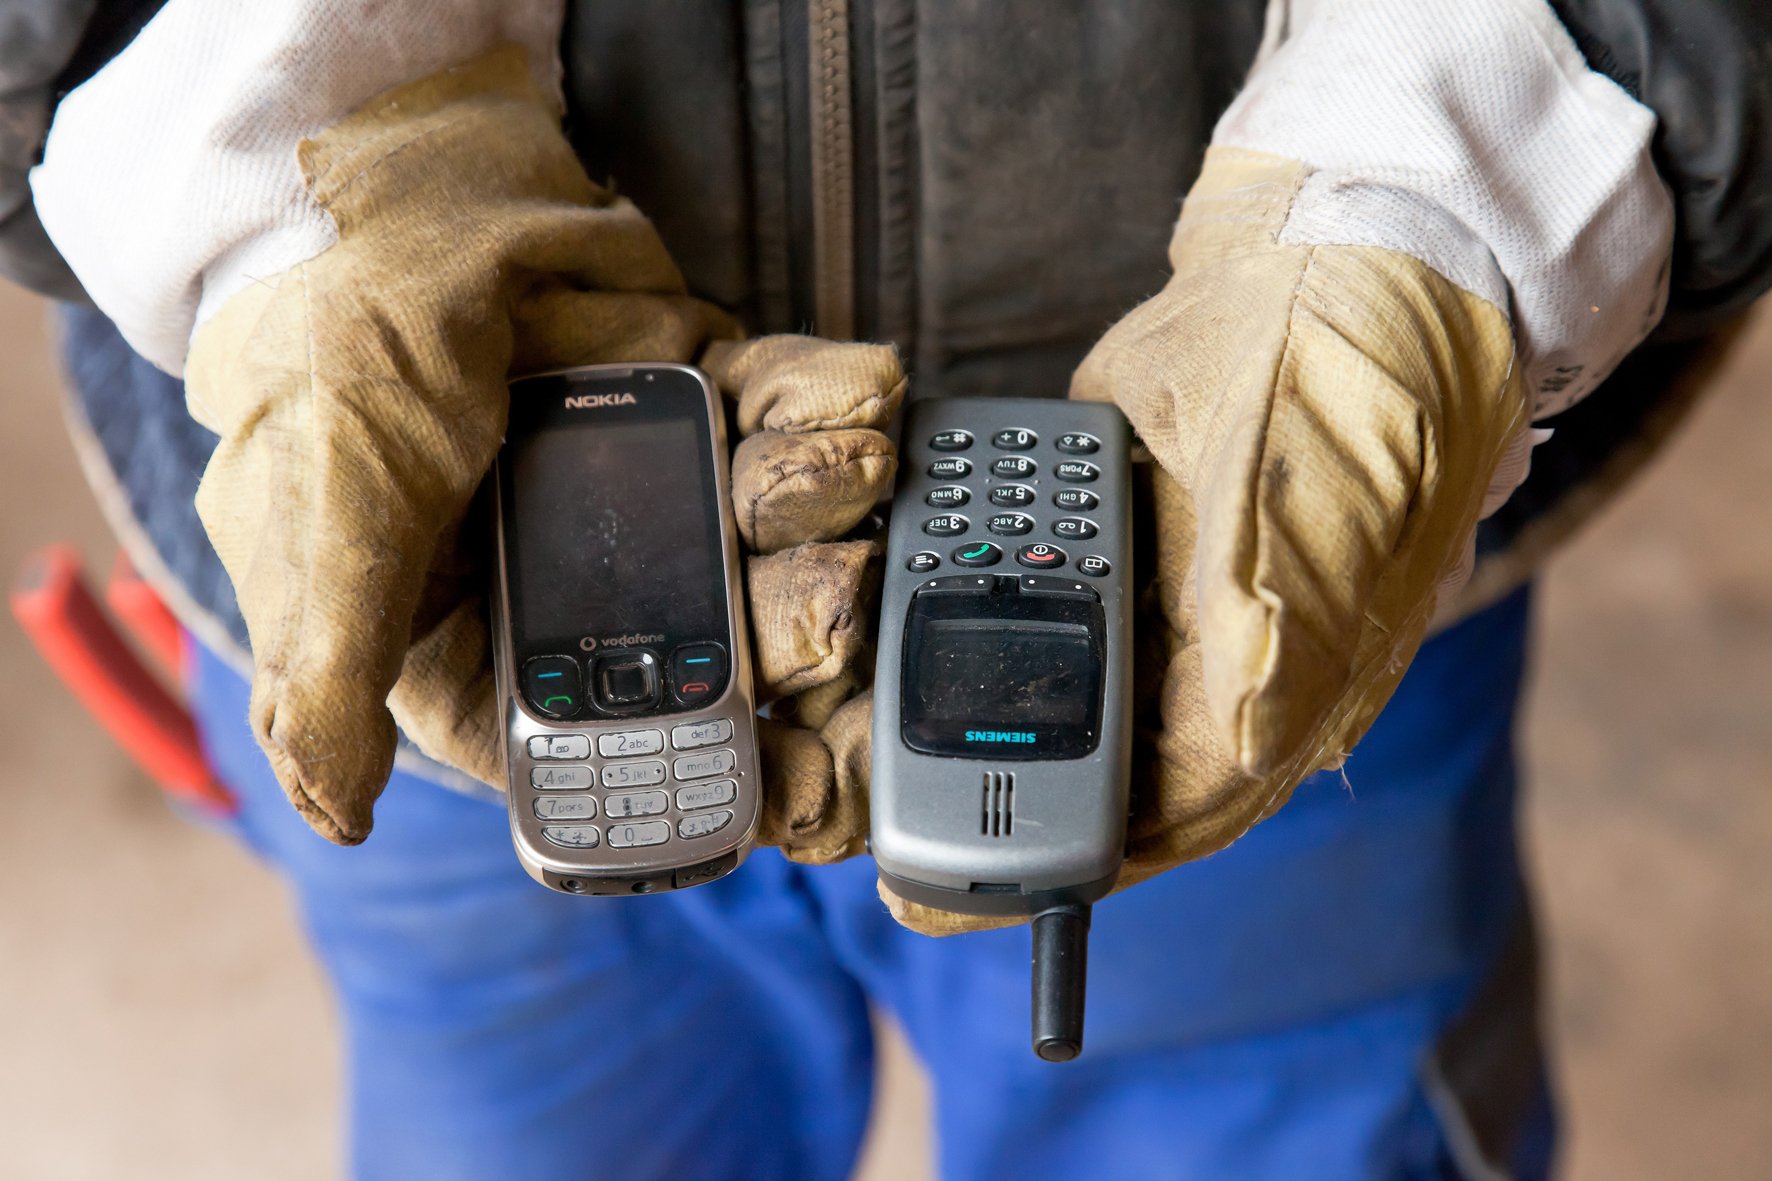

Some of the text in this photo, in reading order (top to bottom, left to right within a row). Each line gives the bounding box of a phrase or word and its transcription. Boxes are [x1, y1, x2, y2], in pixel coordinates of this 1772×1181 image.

[564, 393, 637, 409] NOKIA
[955, 460, 965, 472] 9
[1018, 459, 1027, 471] 8
[1082, 464, 1090, 475] 7
[1016, 487, 1025, 499] 5
[1080, 492, 1089, 503] 4
[950, 517, 959, 529] 3
[1015, 516, 1024, 528] 2
[1080, 521, 1087, 533] 1
[601, 633, 665, 647] vodafone
[712, 726, 721, 739] 3
[965, 731, 1036, 743] SIEMENS
[618, 736, 649, 752] 2 abc
[713, 756, 722, 770] 6
[544, 770, 575, 784] 4 ghi
[620, 768, 628, 781] 5
[547, 801, 556, 814] 7
[625, 830, 633, 841] 0
